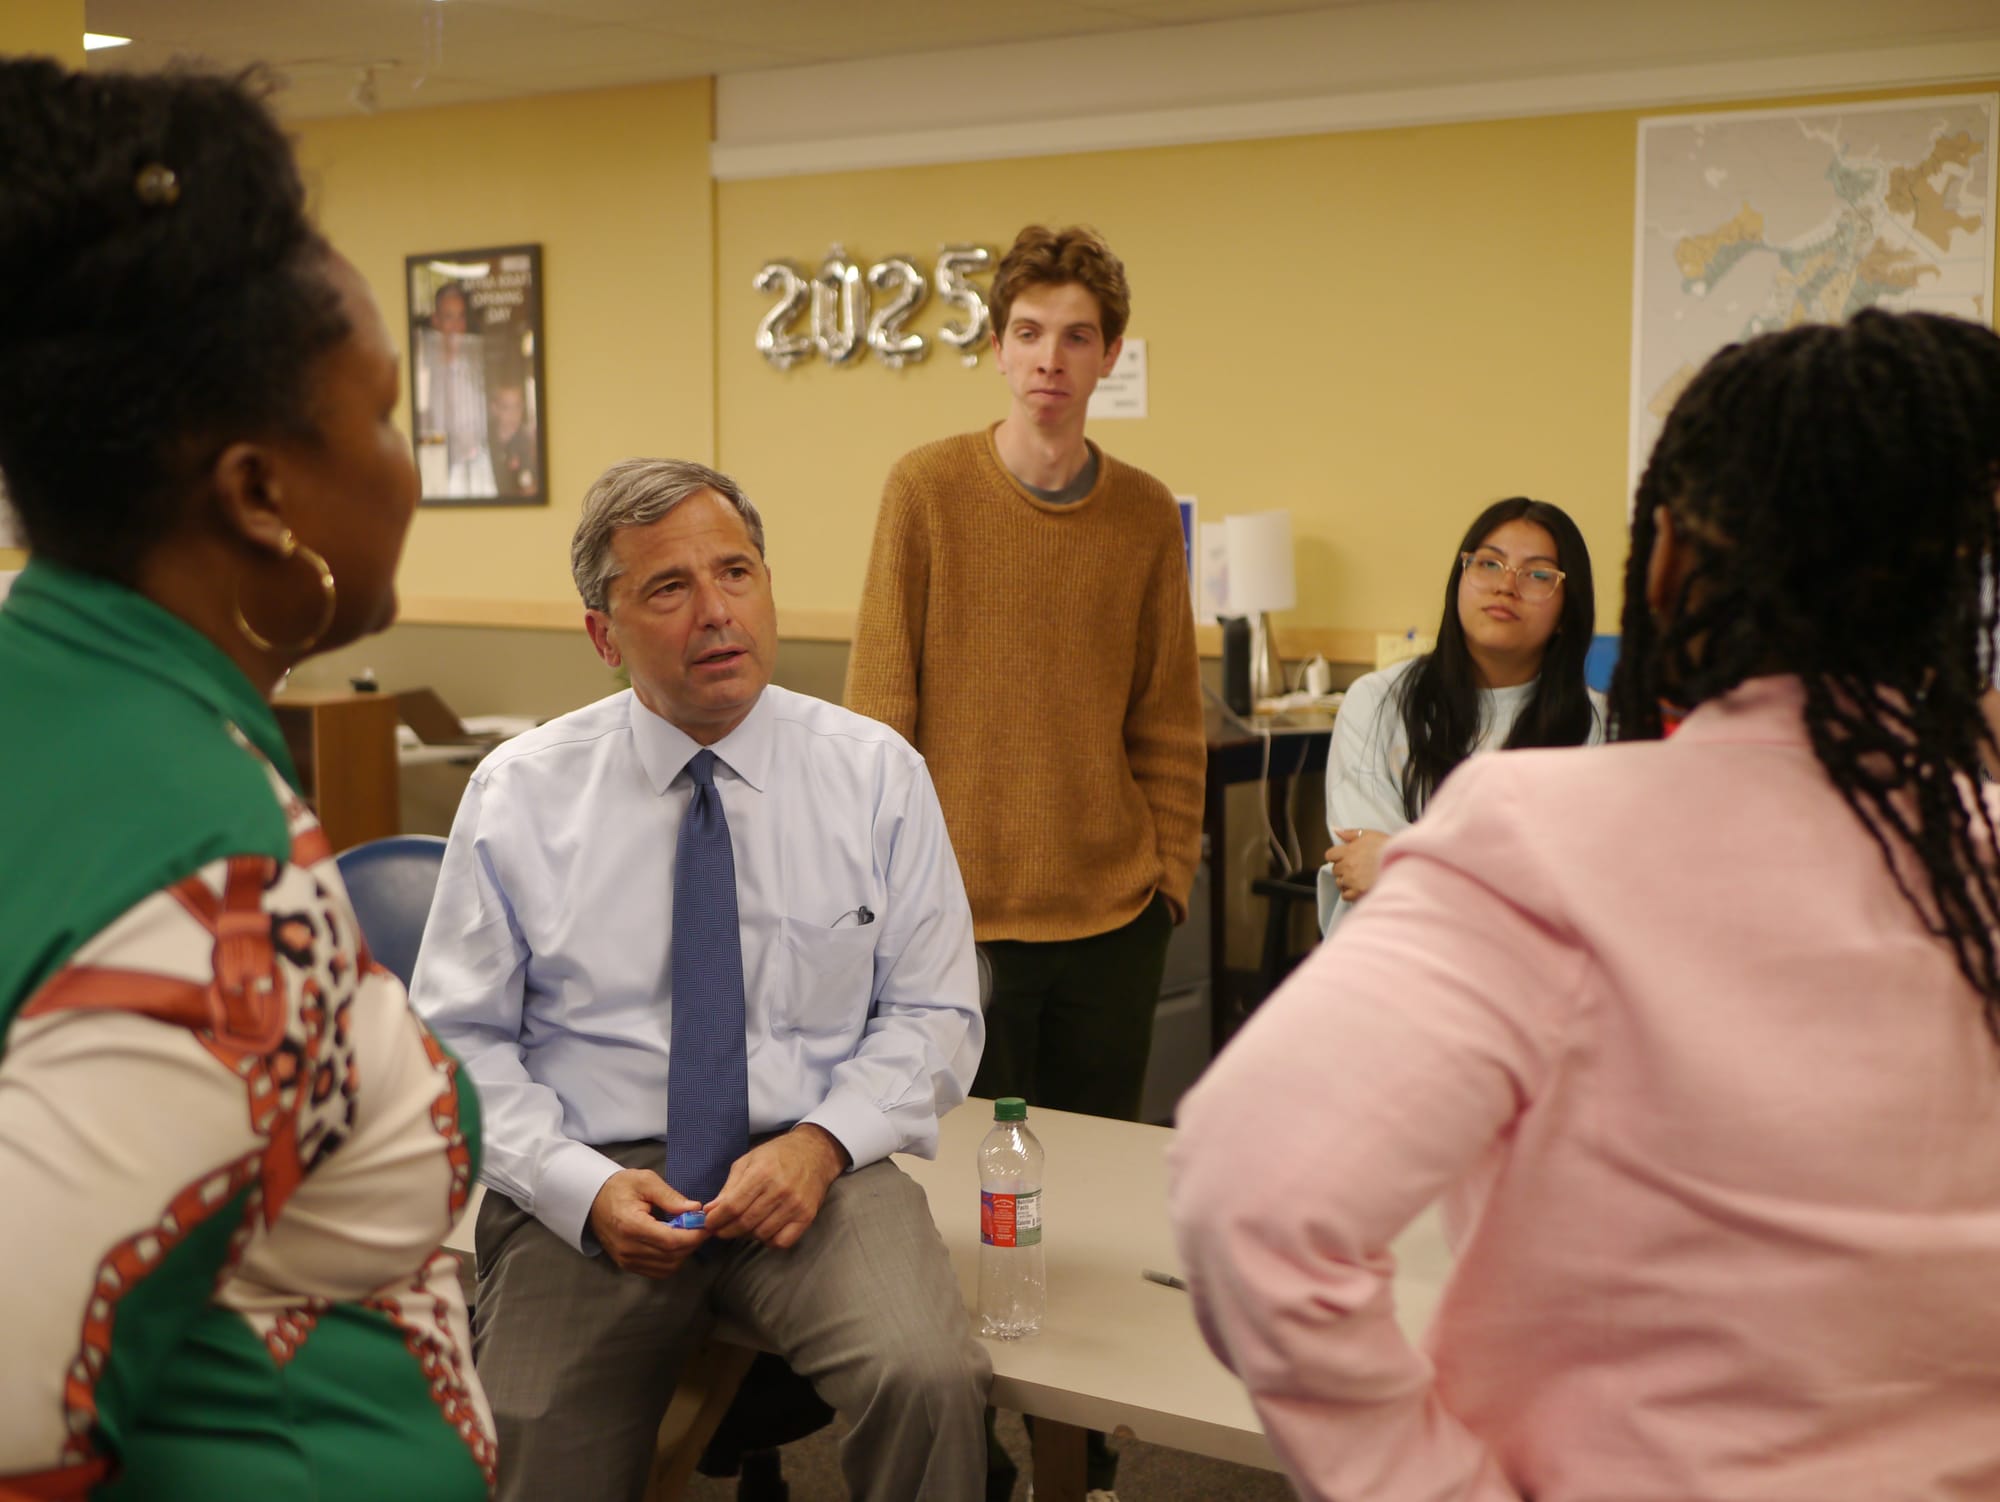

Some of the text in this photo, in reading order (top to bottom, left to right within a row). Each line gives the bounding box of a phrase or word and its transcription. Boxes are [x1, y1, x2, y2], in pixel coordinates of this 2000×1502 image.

[472, 290, 524, 308] OPENING
[753, 244, 991, 368] 2025
[486, 307, 512, 323] DAY
